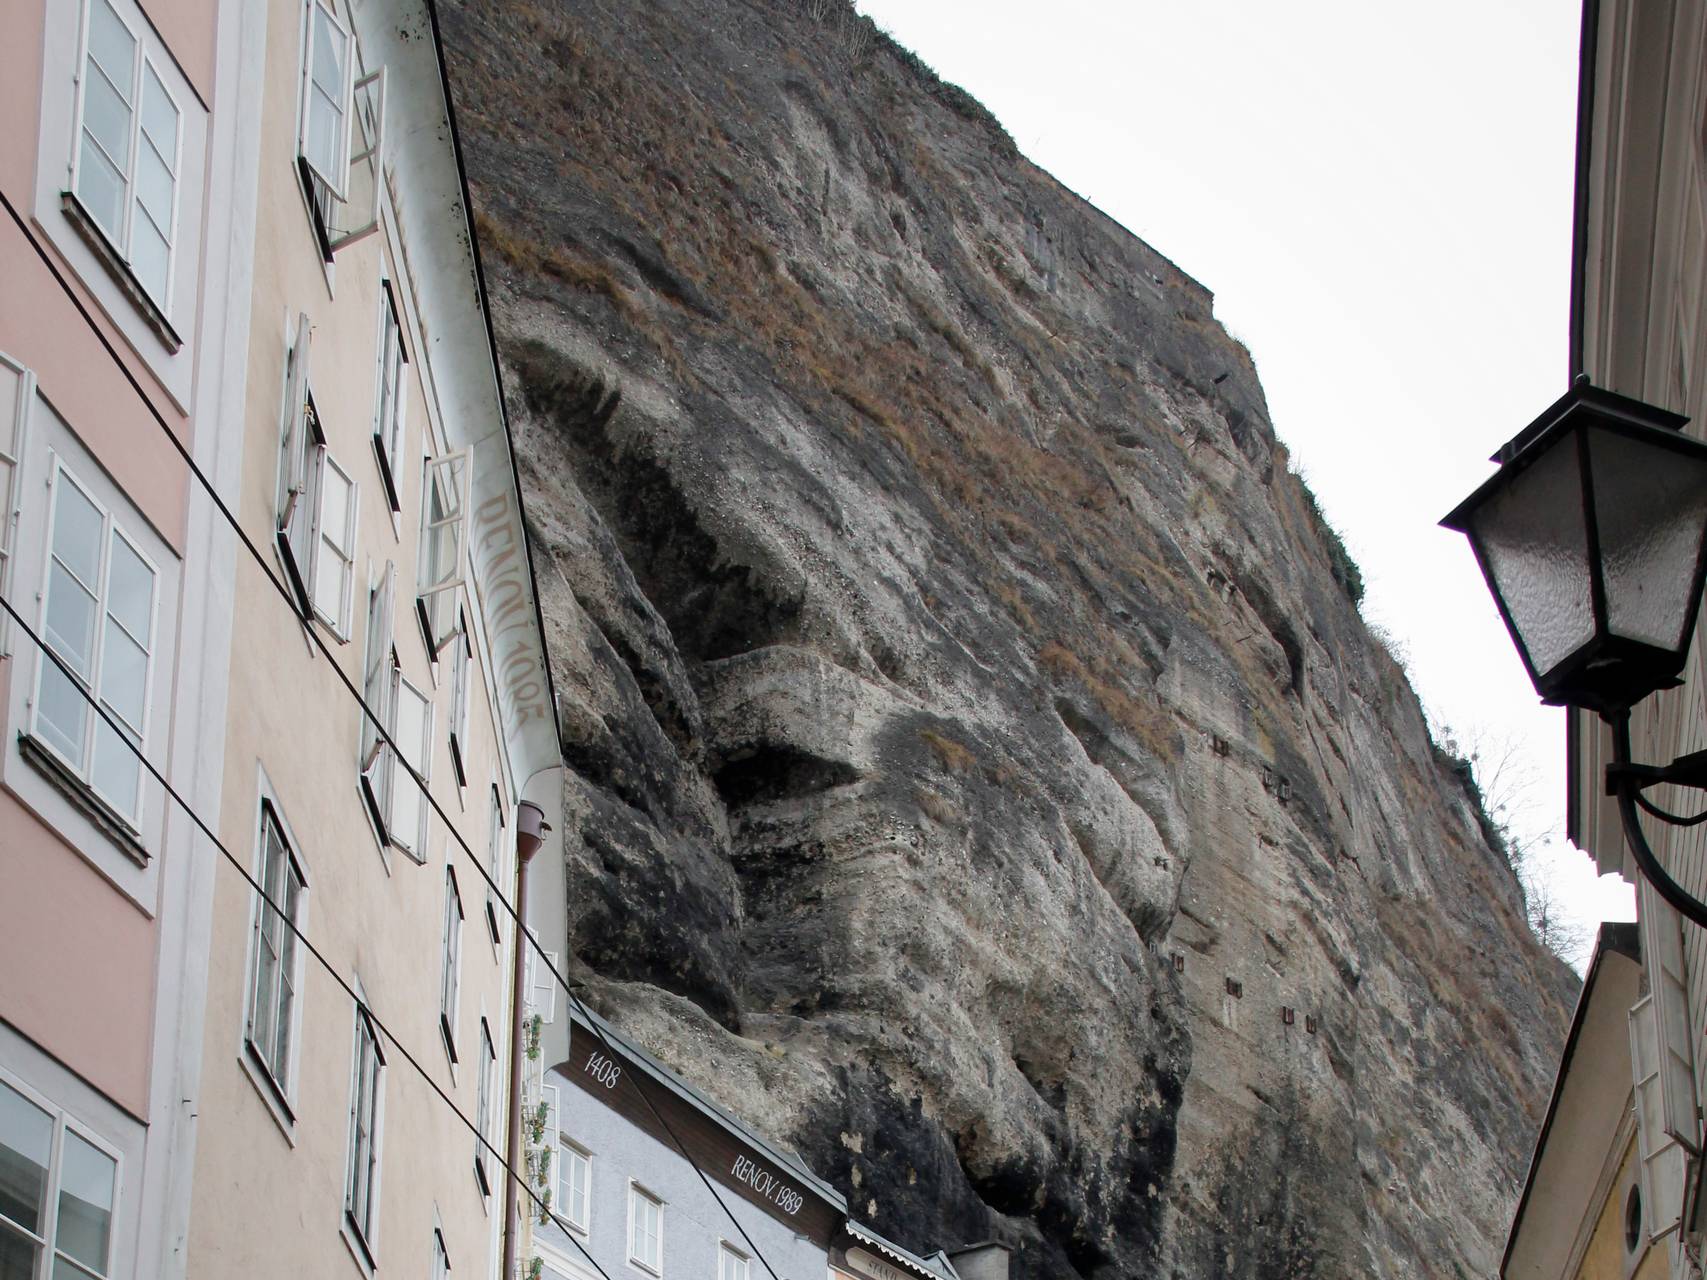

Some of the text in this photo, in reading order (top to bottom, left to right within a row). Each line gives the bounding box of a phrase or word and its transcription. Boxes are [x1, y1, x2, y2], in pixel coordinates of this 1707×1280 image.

[584, 1051, 622, 1089] 1408
[731, 1154, 804, 1216] RENOV. 1989
